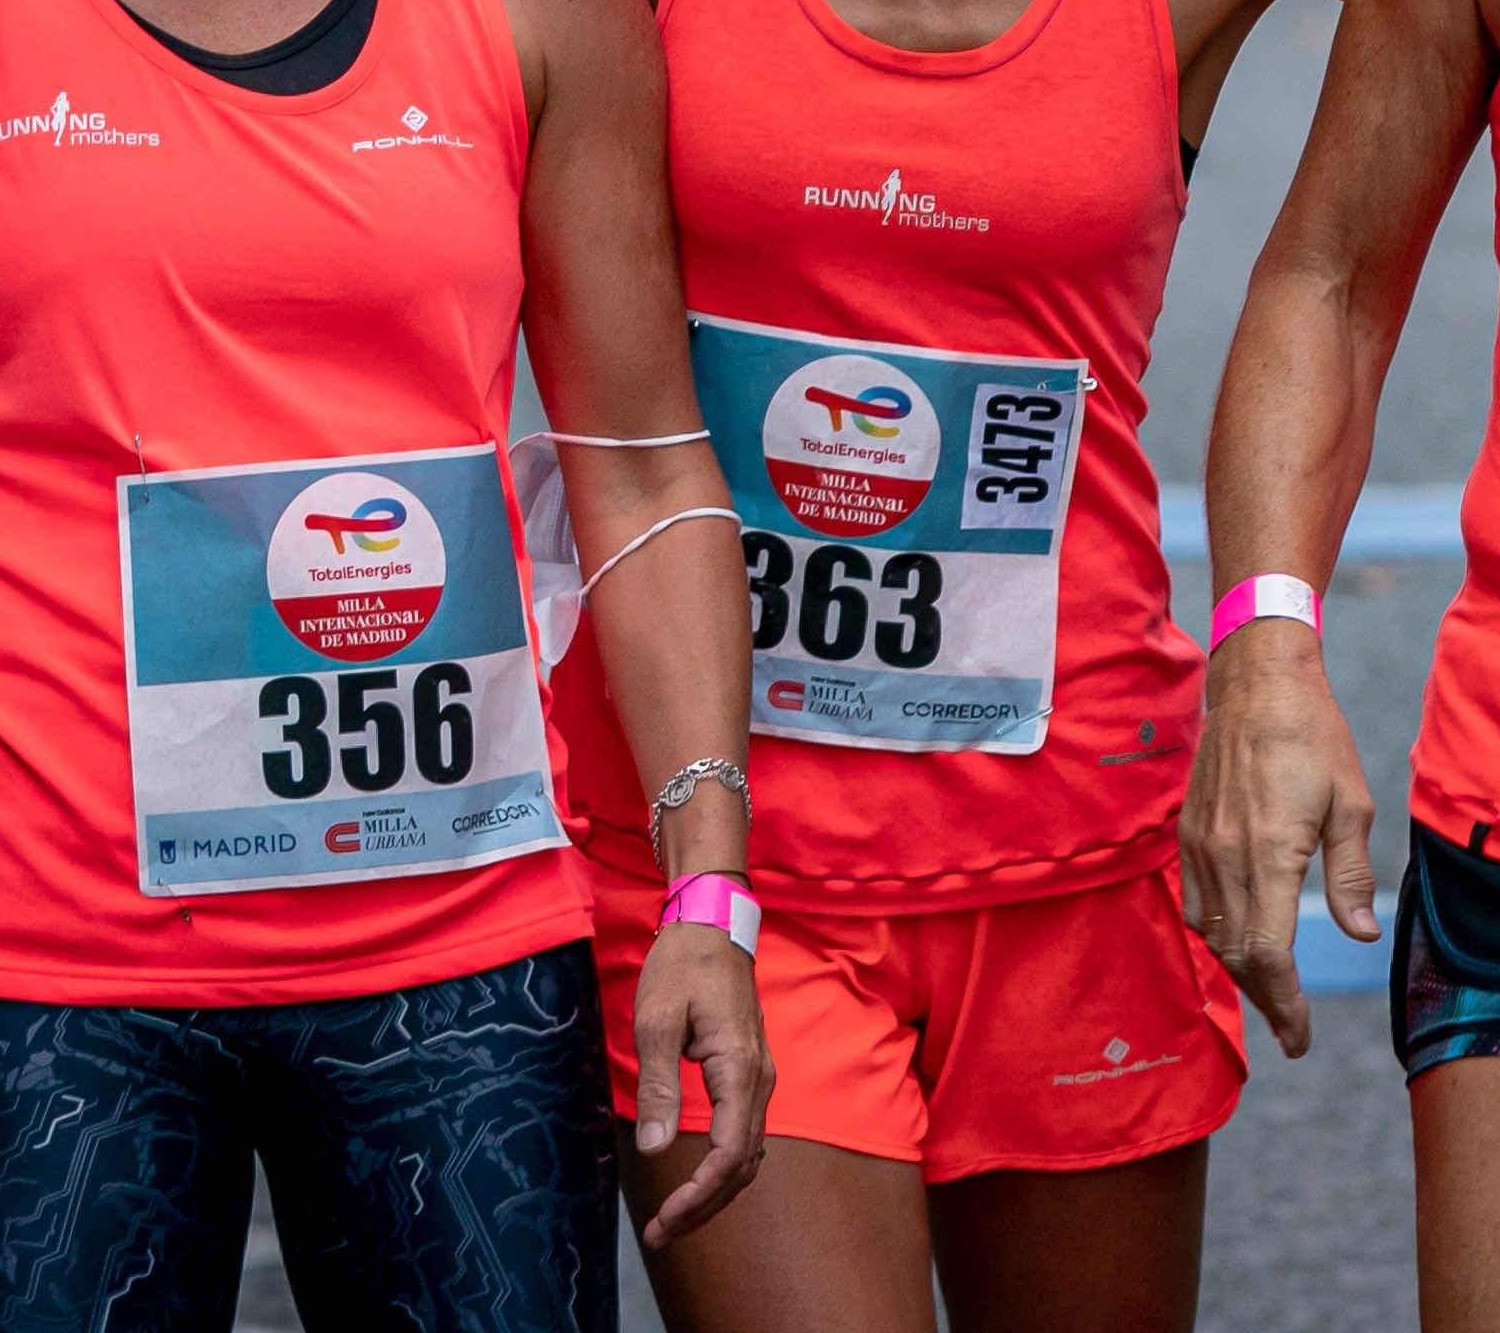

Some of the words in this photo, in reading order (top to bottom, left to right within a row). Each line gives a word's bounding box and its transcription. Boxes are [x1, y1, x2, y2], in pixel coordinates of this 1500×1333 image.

[70, 128, 160, 147] mothers
[353, 134, 474, 153] RONHILL
[899, 209, 990, 232] mothers
[800, 437, 907, 464] TotalEnergies
[975, 393, 1063, 504] 3473
[820, 473, 872, 492] MILLA
[797, 501, 820, 518] DE
[822, 506, 888, 526] MADRID
[308, 561, 413, 582] TotalEnergies
[337, 595, 386, 615] MILLA
[320, 633, 344, 649] DE
[346, 627, 407, 646] MADRID
[809, 684, 867, 704] MILLA
[258, 663, 475, 800] 356
[364, 815, 418, 834] MILLA
[192, 832, 298, 860] MADRID
[364, 831, 427, 852] URBANA
